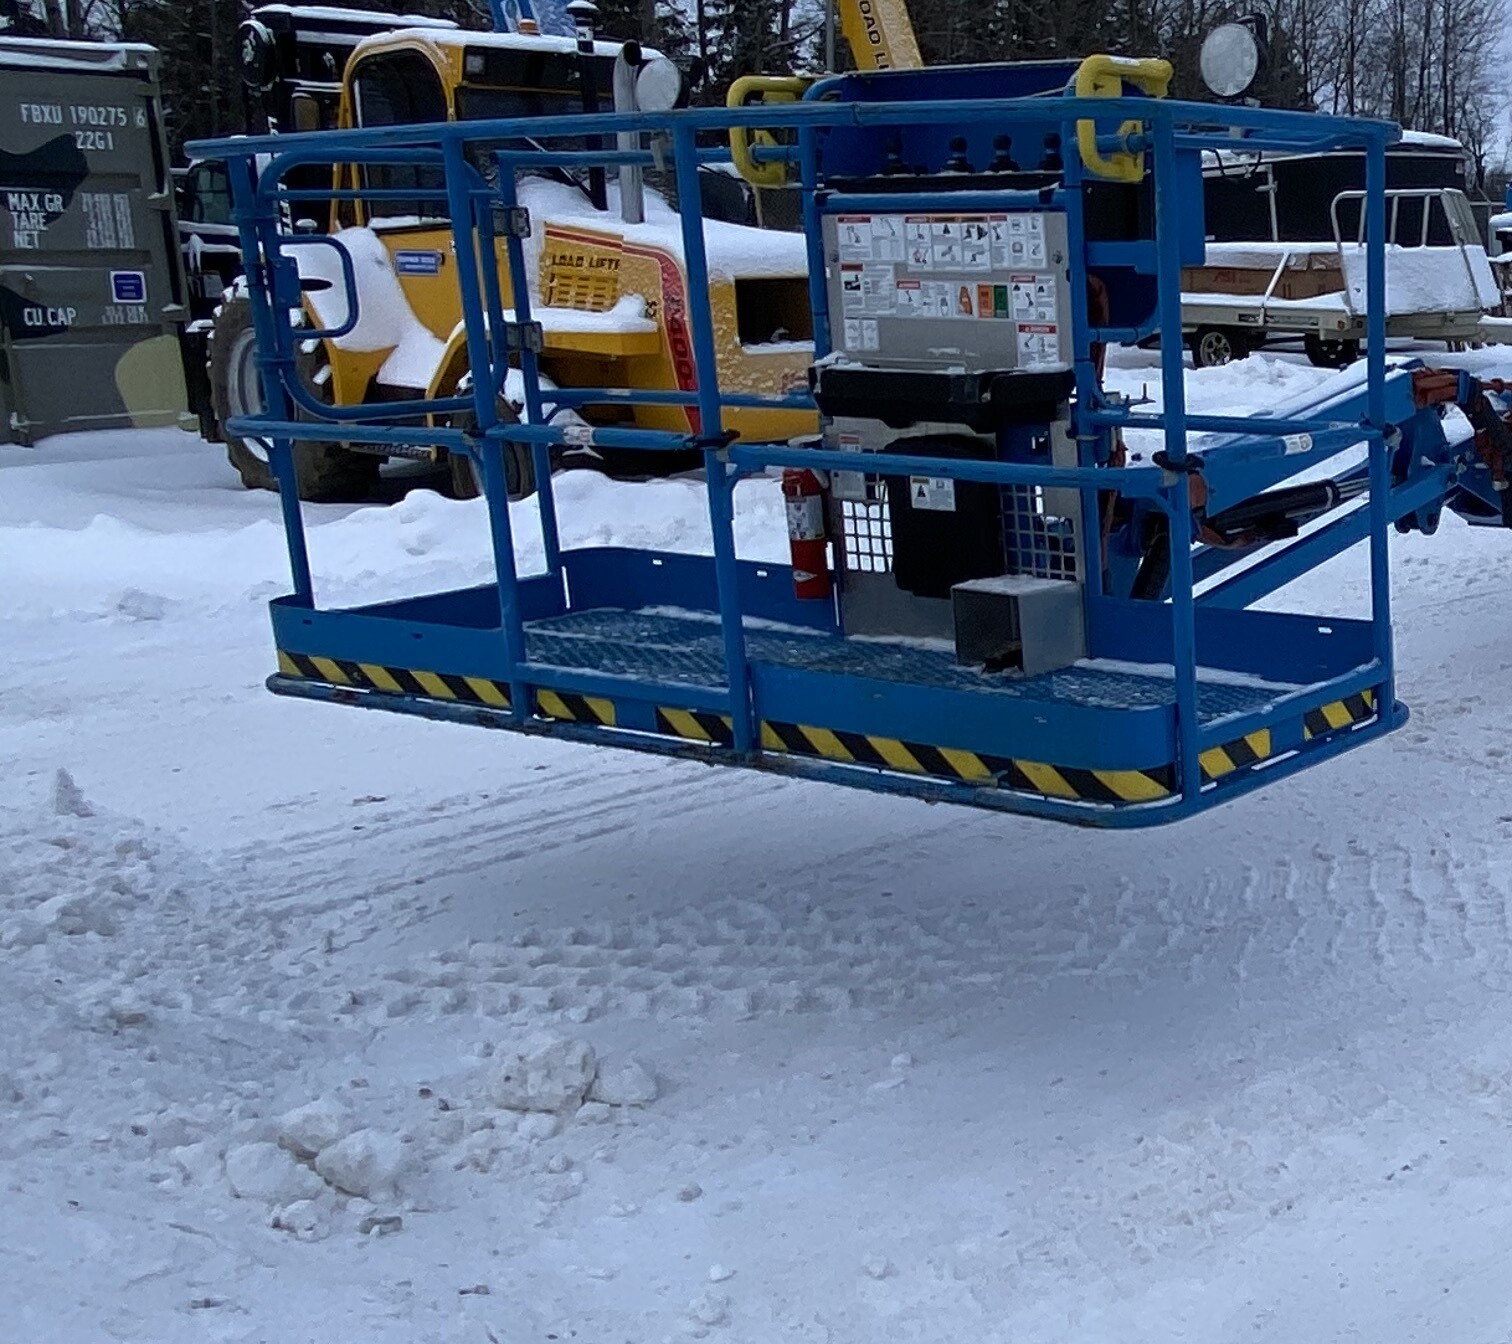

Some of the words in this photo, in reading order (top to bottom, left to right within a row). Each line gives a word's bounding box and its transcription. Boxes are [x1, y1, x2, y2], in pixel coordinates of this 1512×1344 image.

[20, 103, 62, 125] FBXU
[69, 105, 128, 127] 190275
[10, 211, 49, 231] TARE
[13, 230, 40, 249] NET
